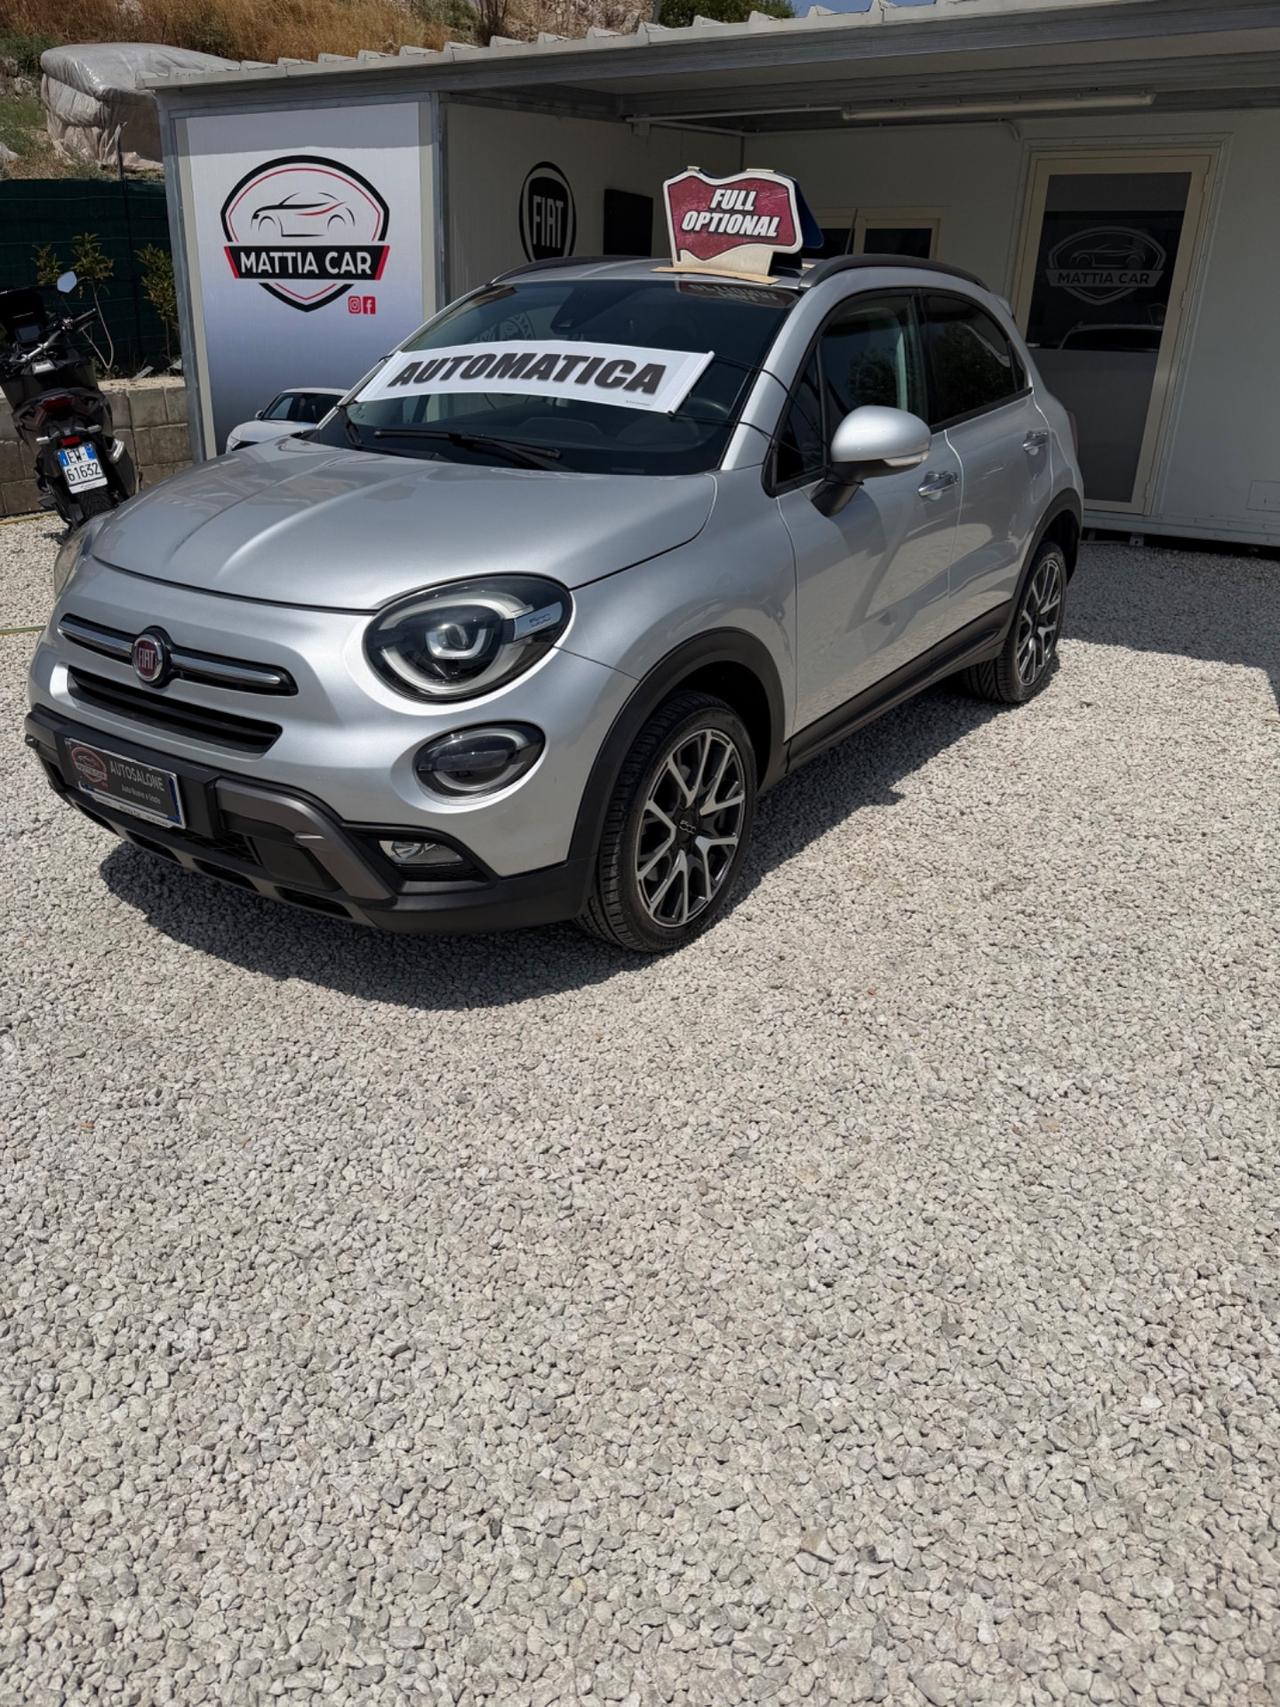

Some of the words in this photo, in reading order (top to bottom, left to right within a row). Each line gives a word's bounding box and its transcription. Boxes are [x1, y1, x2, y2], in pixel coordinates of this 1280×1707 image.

[709, 188, 757, 211] FULL
[533, 195, 564, 249] FIAT
[681, 211, 780, 237] OPTIONAL
[239, 251, 319, 274] MATTIA
[325, 251, 372, 274] CAR
[1056, 272, 1115, 284] MATTIA
[1118, 272, 1150, 284] CAR
[387, 352, 667, 395] AUTOMATICA
[66, 462, 102, 482] 61632
[138, 647, 155, 670] FIAT
[110, 760, 165, 792] AUTOSALONE
